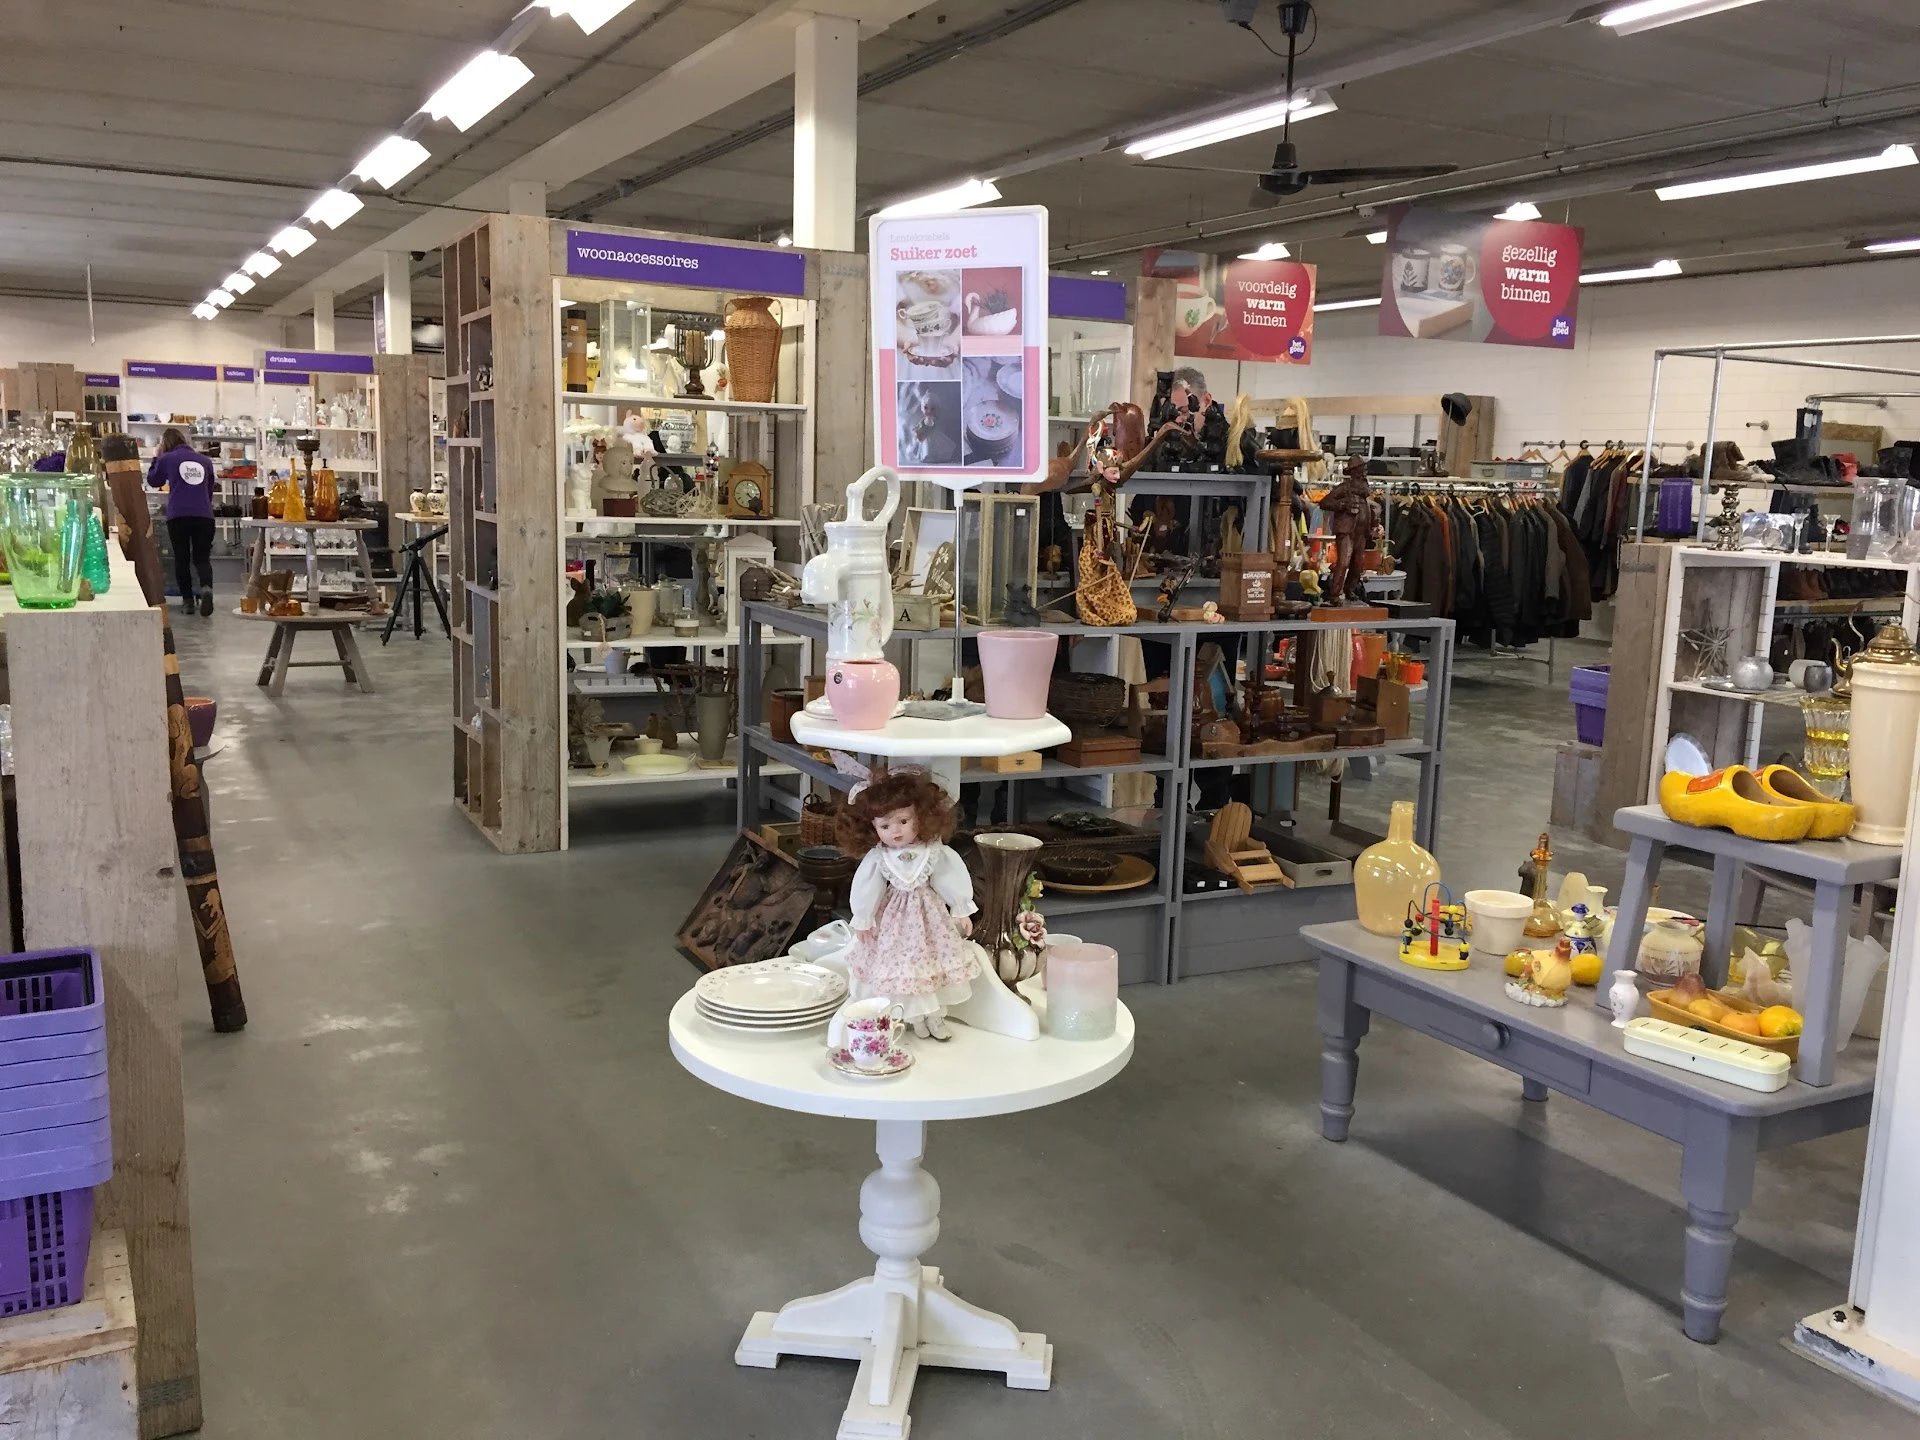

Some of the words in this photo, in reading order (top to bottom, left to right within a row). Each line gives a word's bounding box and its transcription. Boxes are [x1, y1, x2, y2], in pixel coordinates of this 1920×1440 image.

[577, 246, 699, 270] woonaccessoires
[890, 246, 942, 261] Suiker
[944, 244, 978, 259] zoet
[1501, 244, 1558, 268] gezellig
[1505, 266, 1551, 284] warm
[1237, 280, 1298, 299] voordelig
[1500, 283, 1551, 304] binnen
[1246, 297, 1286, 311] warm
[1243, 311, 1287, 327] binnen
[1556, 319, 1567, 328] het
[1552, 326, 1569, 337] goed
[1289, 345, 1305, 355] goed
[1292, 340, 1302, 348] het
[269, 355, 297, 364] drinken
[184, 471, 202, 480] goed
[899, 608, 911, 622] A
